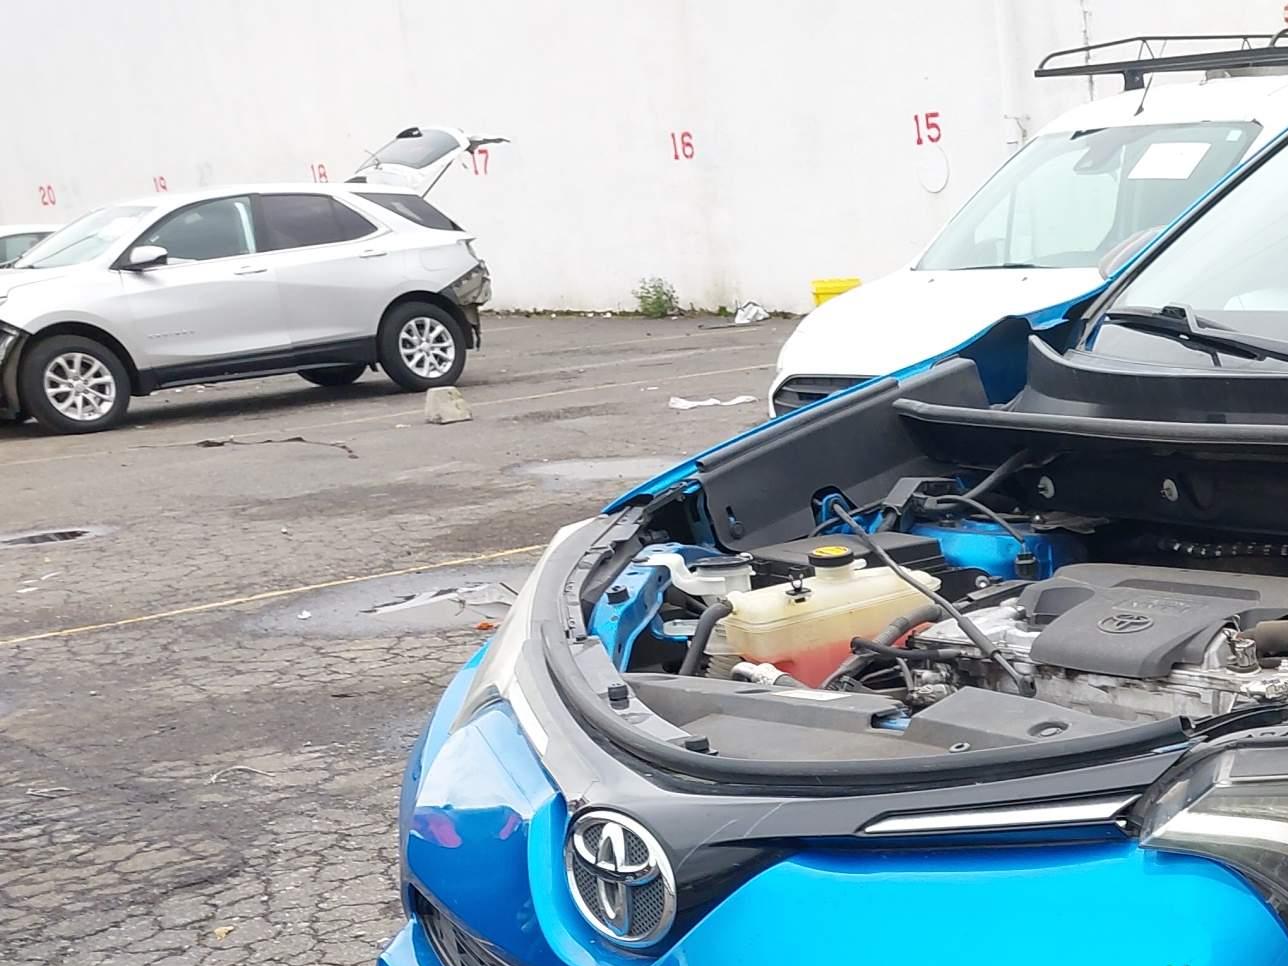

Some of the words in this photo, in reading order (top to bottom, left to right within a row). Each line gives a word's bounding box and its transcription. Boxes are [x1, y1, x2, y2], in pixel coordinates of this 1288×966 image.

[913, 112, 942, 145] 15
[670, 132, 695, 160] 16
[472, 149, 489, 175] 17
[38, 185, 56, 206] 20
